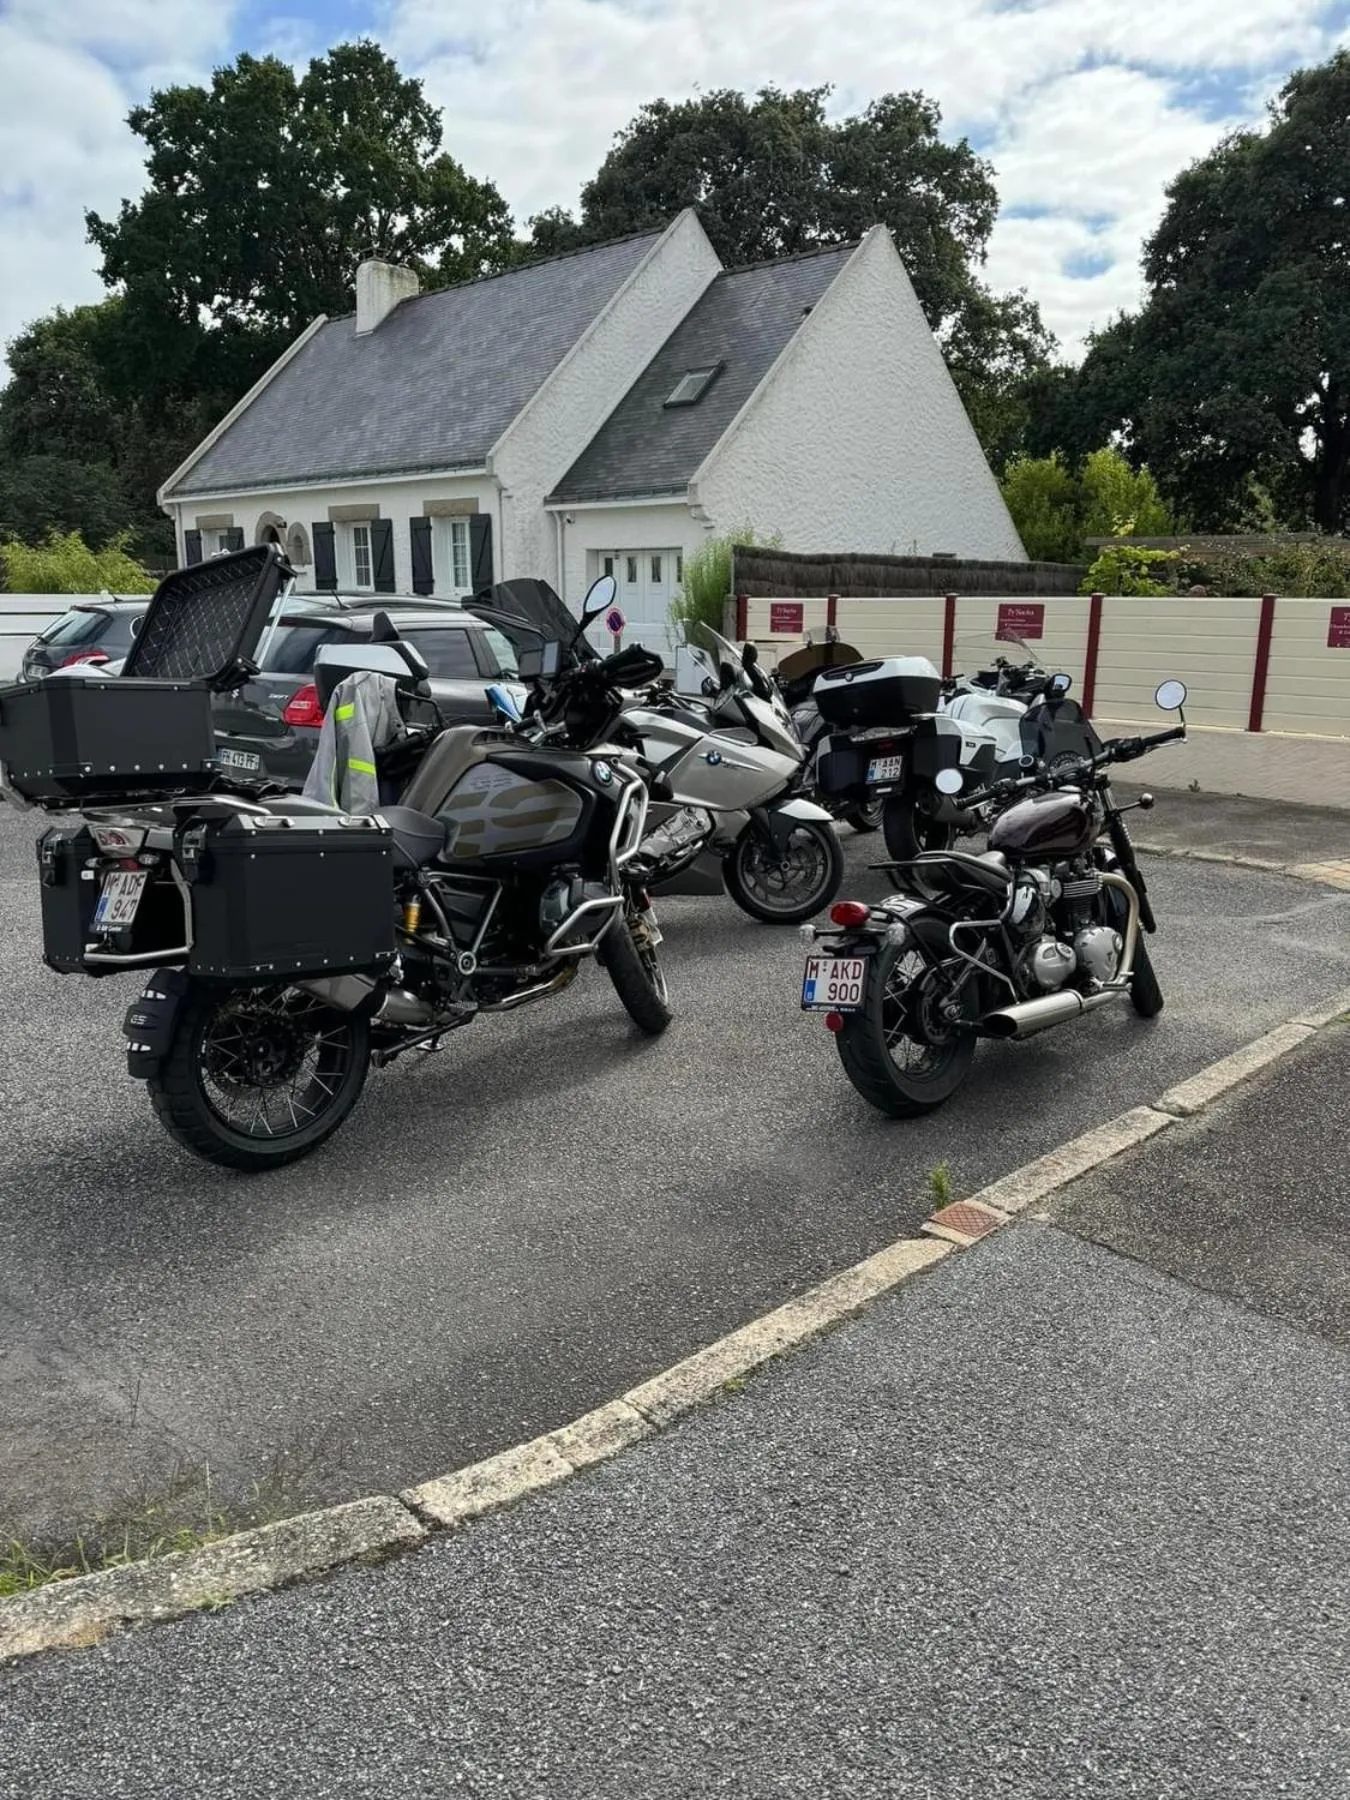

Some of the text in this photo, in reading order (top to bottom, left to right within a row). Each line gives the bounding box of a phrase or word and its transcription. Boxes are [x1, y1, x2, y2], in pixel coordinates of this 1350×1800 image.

[111, 899, 138, 920] 947
[809, 961, 863, 980] M AKD
[827, 982, 860, 1002] 900
